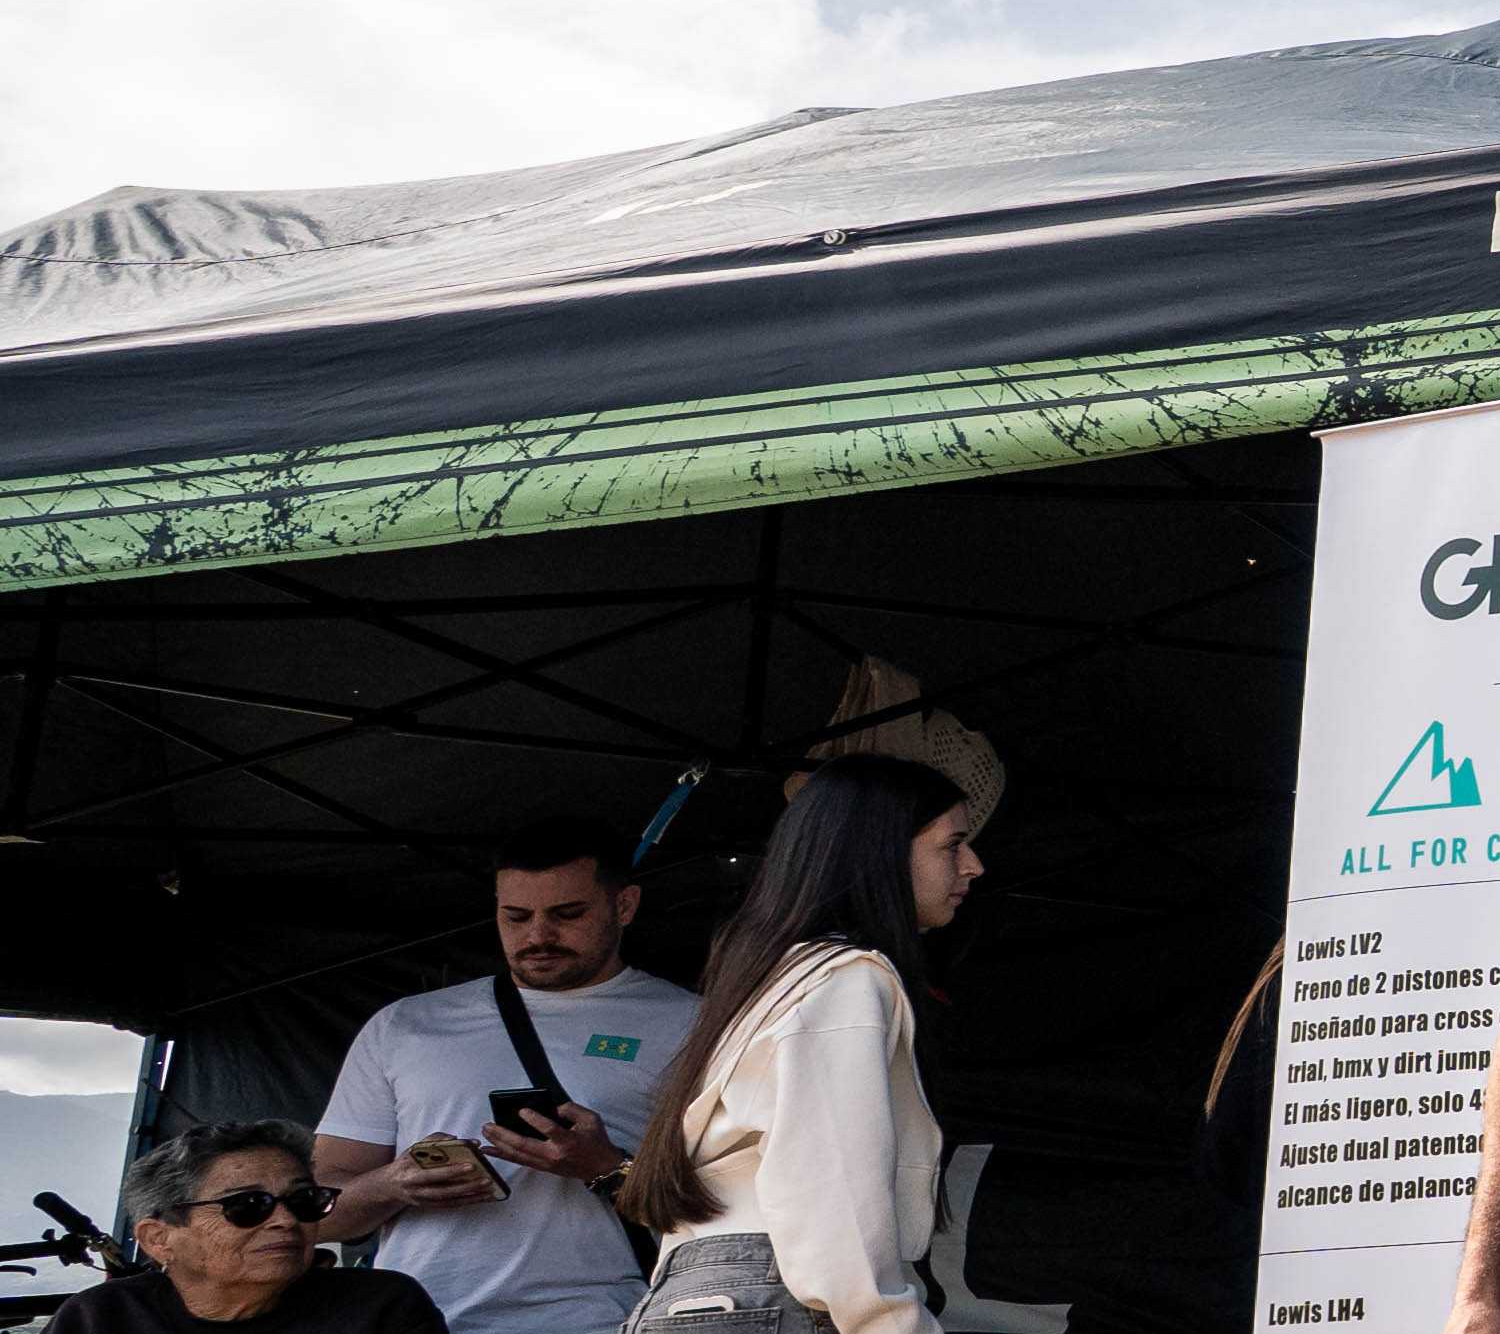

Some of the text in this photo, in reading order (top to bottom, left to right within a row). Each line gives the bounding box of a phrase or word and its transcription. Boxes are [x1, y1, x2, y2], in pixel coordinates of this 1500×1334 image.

[1340, 843, 1391, 876] ALL
[1410, 837, 1467, 867] FOR
[1297, 931, 1383, 963] Lewis LV2
[1294, 977, 1342, 1003] Freno
[1347, 974, 1370, 997] de
[1375, 971, 1386, 995] 2
[1391, 967, 1484, 995] pistones
[1290, 1014, 1376, 1044] Diseñado
[1381, 1010, 1428, 1037] para
[1434, 1007, 1494, 1031] cross
[1288, 1048, 1491, 1085] trial, bmx y dirt jump
[1284, 1102, 1298, 1126] El
[1302, 1099, 1341, 1124] más
[1346, 1095, 1413, 1122] ligero,
[1418, 1090, 1464, 1115] solo
[1280, 1140, 1338, 1169] Ajuste
[1343, 1137, 1389, 1162] dual
[1277, 1175, 1477, 1209] alcance de palanca
[1268, 1297, 1365, 1327] Lewis LH4
